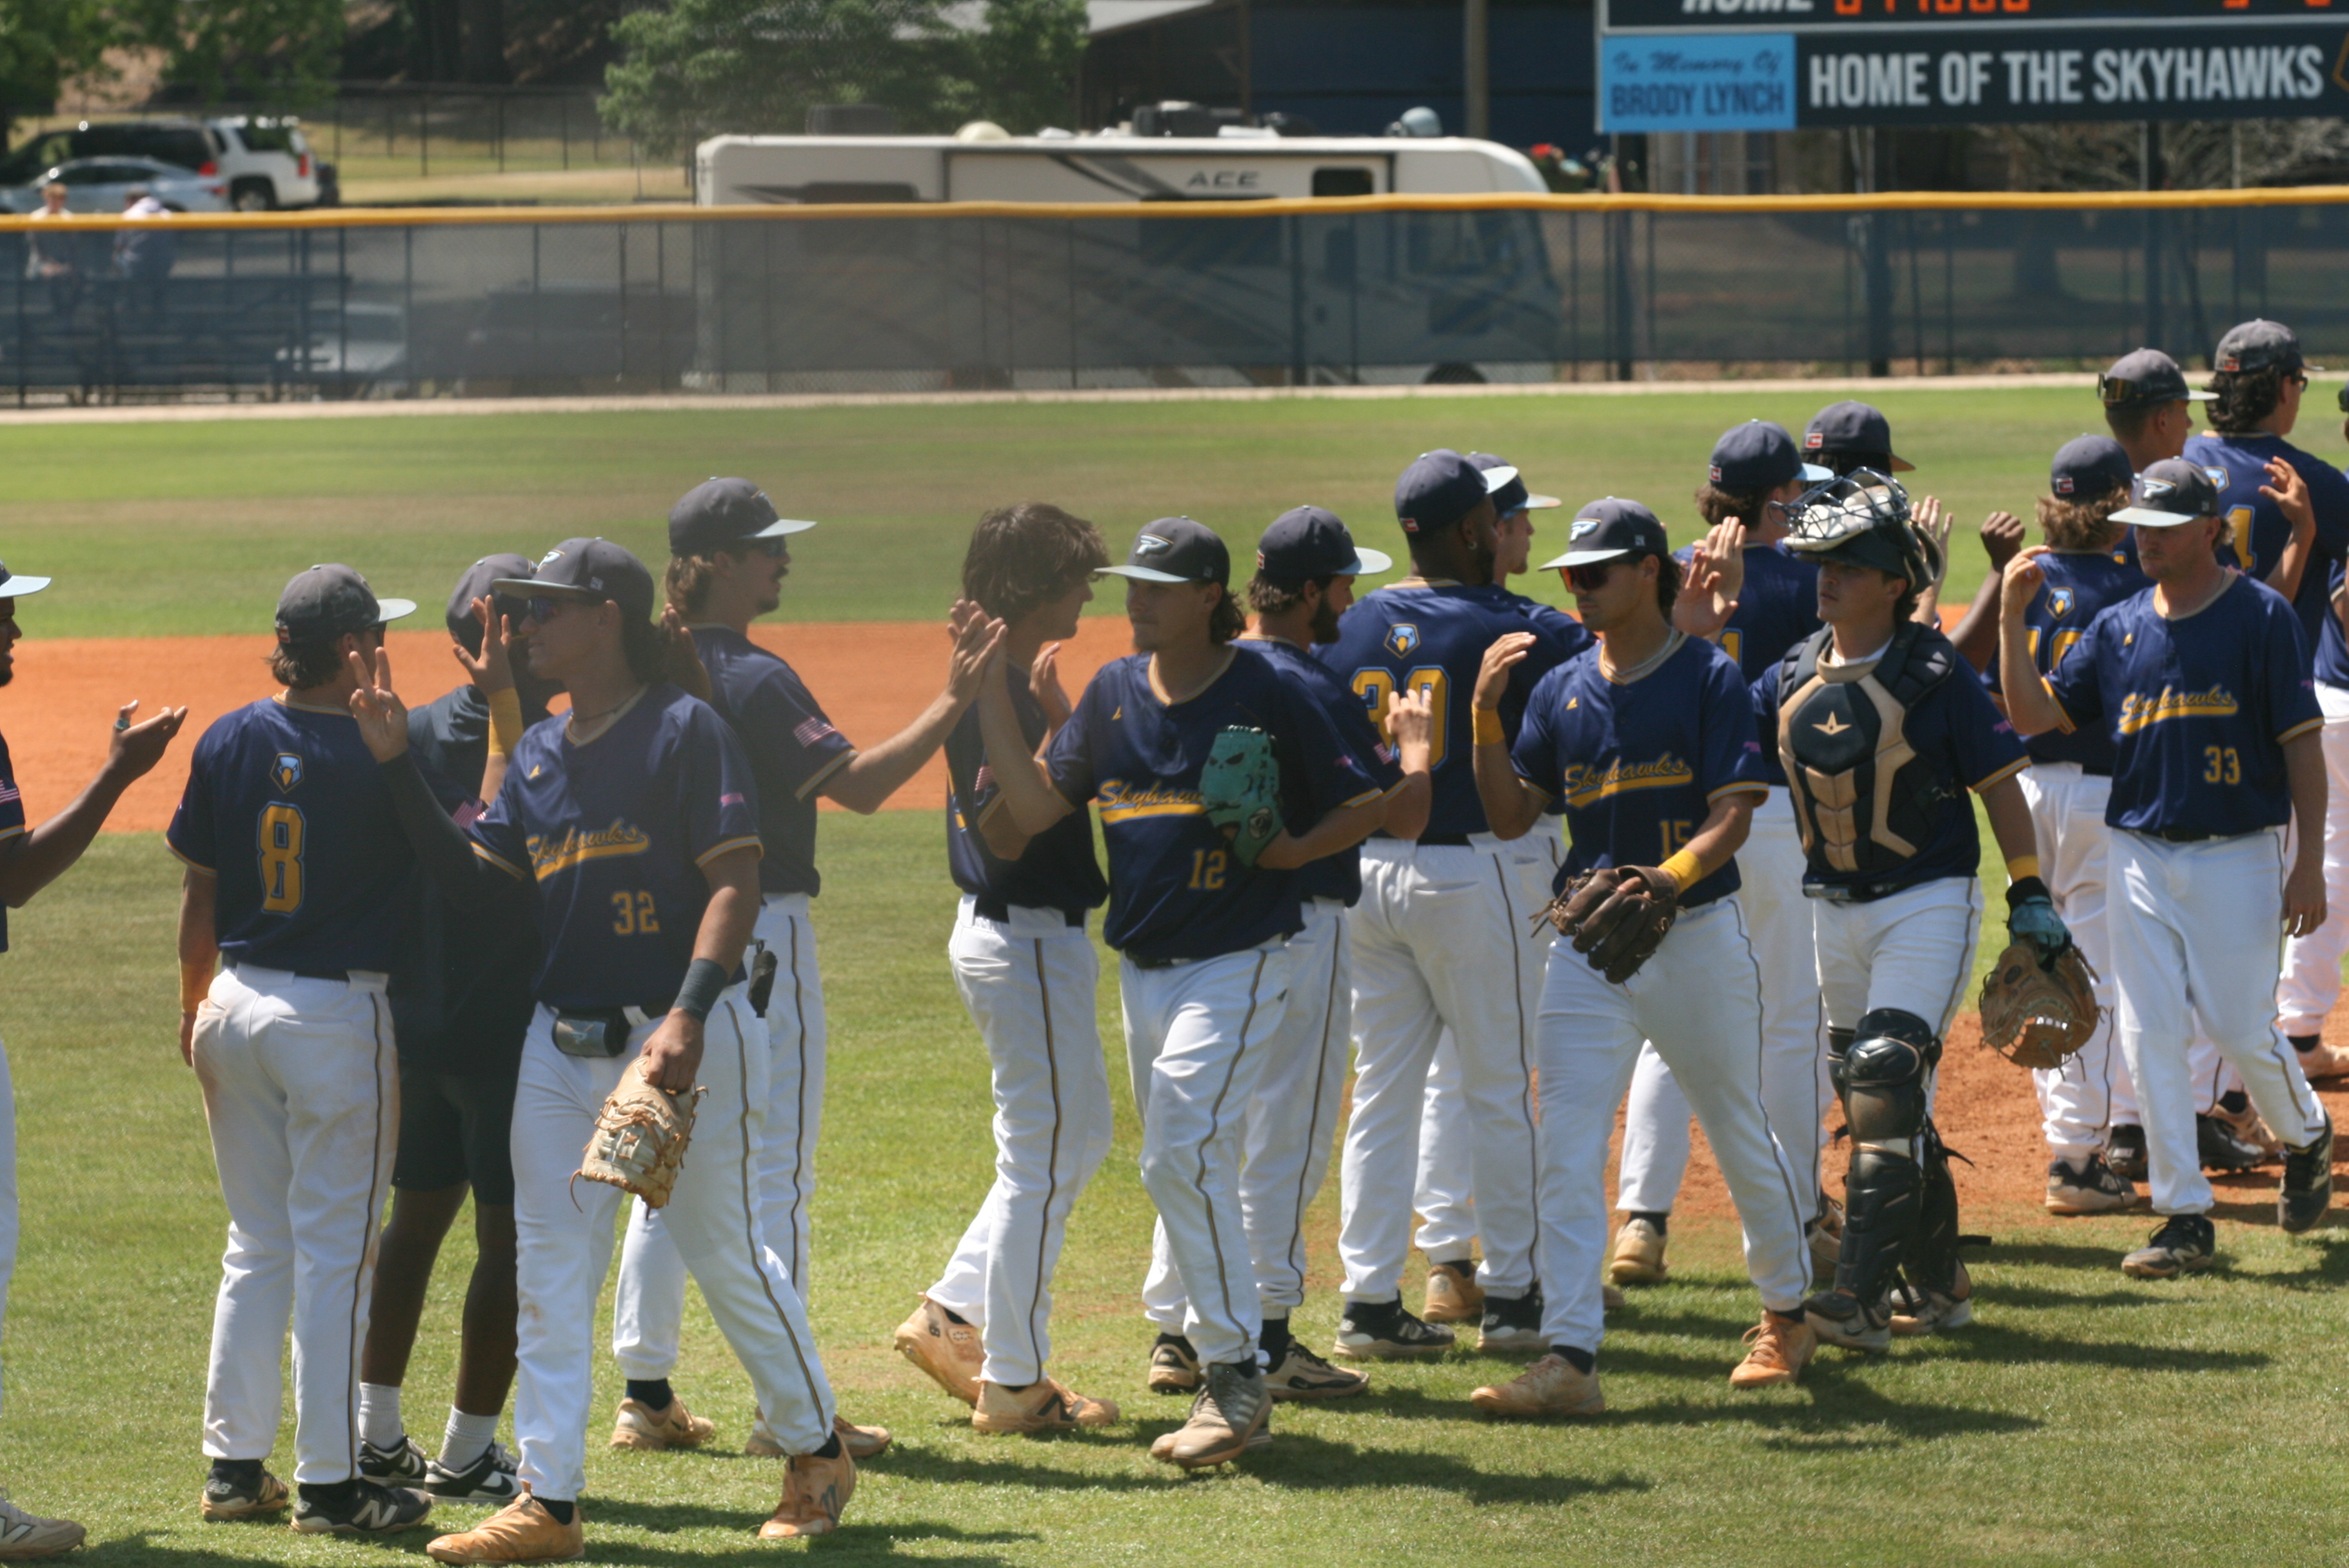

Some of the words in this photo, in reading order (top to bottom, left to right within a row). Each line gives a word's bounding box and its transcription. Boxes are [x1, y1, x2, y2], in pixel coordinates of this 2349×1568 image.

[1809, 53, 1931, 108] HOME
[1939, 52, 1994, 106] OF
[2001, 50, 2085, 104] THE
[2092, 45, 2325, 102] SKYHAWKS
[1702, 82, 1785, 116] LYNCH
[1186, 171, 1260, 190] ACE
[2118, 683, 2239, 731] Skyhawks
[1564, 752, 1693, 803] Skyhawks
[2203, 745, 2242, 785] 33
[257, 801, 307, 918] 8
[1188, 849, 1227, 890] 12
[611, 891, 660, 935] 32
